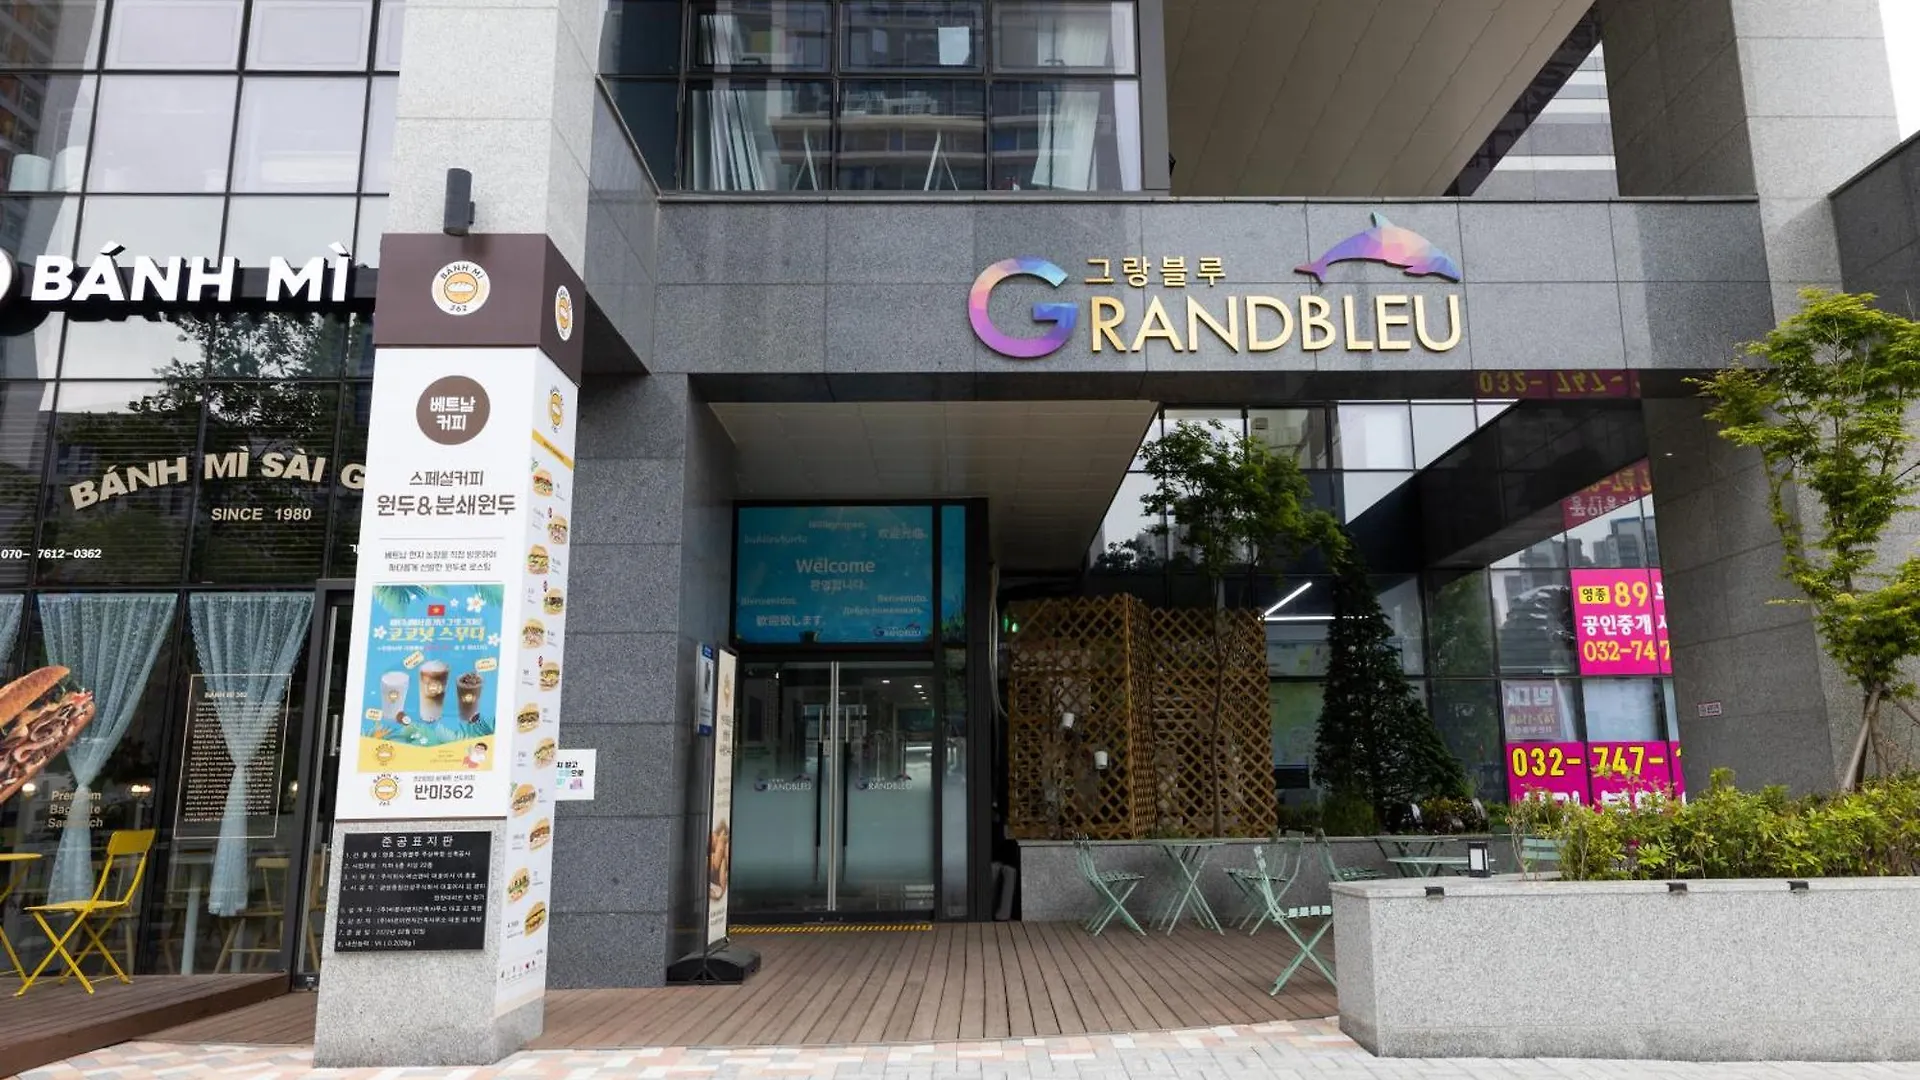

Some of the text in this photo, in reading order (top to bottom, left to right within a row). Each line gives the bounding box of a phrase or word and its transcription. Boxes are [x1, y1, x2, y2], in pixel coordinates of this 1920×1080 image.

[30, 241, 354, 302] BÁNH MÌ
[1085, 256, 1227, 289] 그랑블루
[968, 254, 1463, 360] GRANDBLEU
[430, 396, 476, 413] 베트남
[436, 414, 467, 432] 커피
[70, 456, 188, 511] BÁNH
[204, 446, 250, 480] MÌ
[409, 470, 484, 487] 스페셜커피
[211, 507, 312, 522] SINCE 1980
[795, 558, 876, 574] Welcome
[1582, 587, 1606, 602] 영종
[1614, 581, 1649, 608] 89
[414, 784, 474, 801] 반미362
